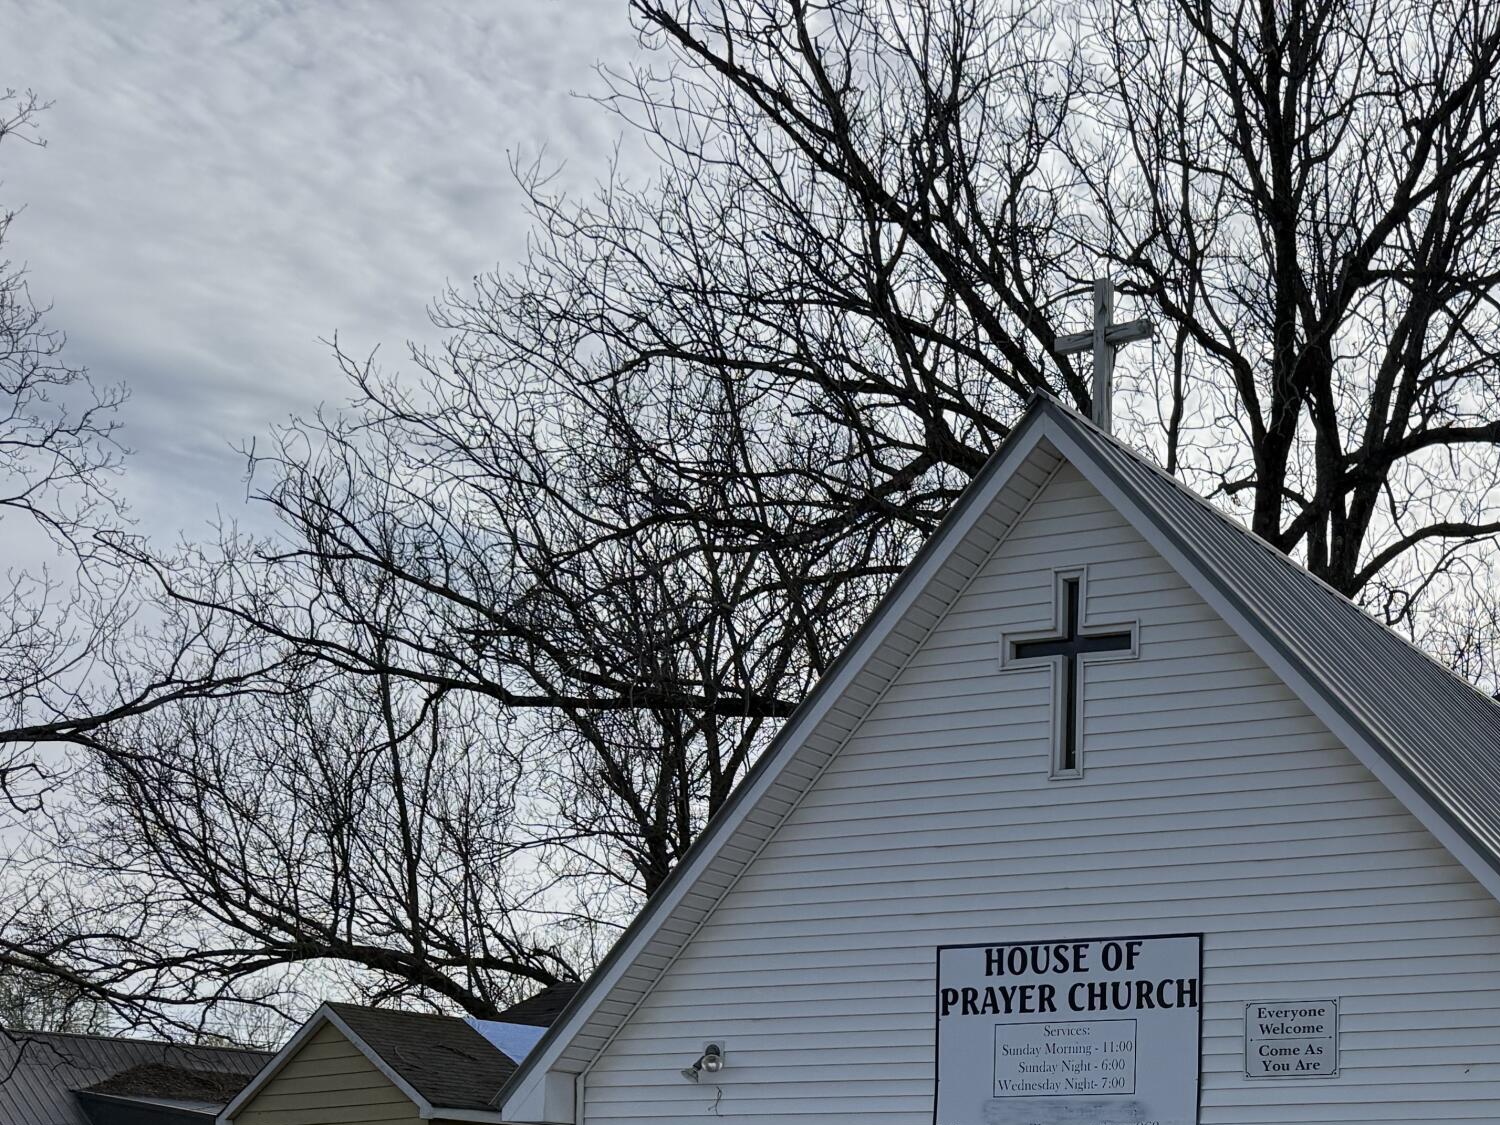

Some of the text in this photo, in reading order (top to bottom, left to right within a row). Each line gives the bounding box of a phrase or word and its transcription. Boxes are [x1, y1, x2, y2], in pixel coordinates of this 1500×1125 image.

[985, 941, 1143, 977] HOUSE OF
[941, 978, 1198, 1016] PRAYER CHURCH
[1257, 1007, 1326, 1022] Everyone
[1043, 1025, 1091, 1037] Services:
[1259, 1022, 1324, 1035] Welcome
[1001, 1043, 1041, 1058] Sunday
[1045, 1042, 1092, 1056] Morning
[1102, 1040, 1133, 1053] 11:00
[1258, 1043, 1323, 1057] Come As
[1018, 1061, 1058, 1075] Sunday
[1061, 1060, 1091, 1074] Night
[1101, 1059, 1126, 1071] 6:00
[1261, 1058, 1321, 1072] You Are
[998, 1079, 1061, 1092] Wednesday
[1101, 1076, 1125, 1089] 7:00
